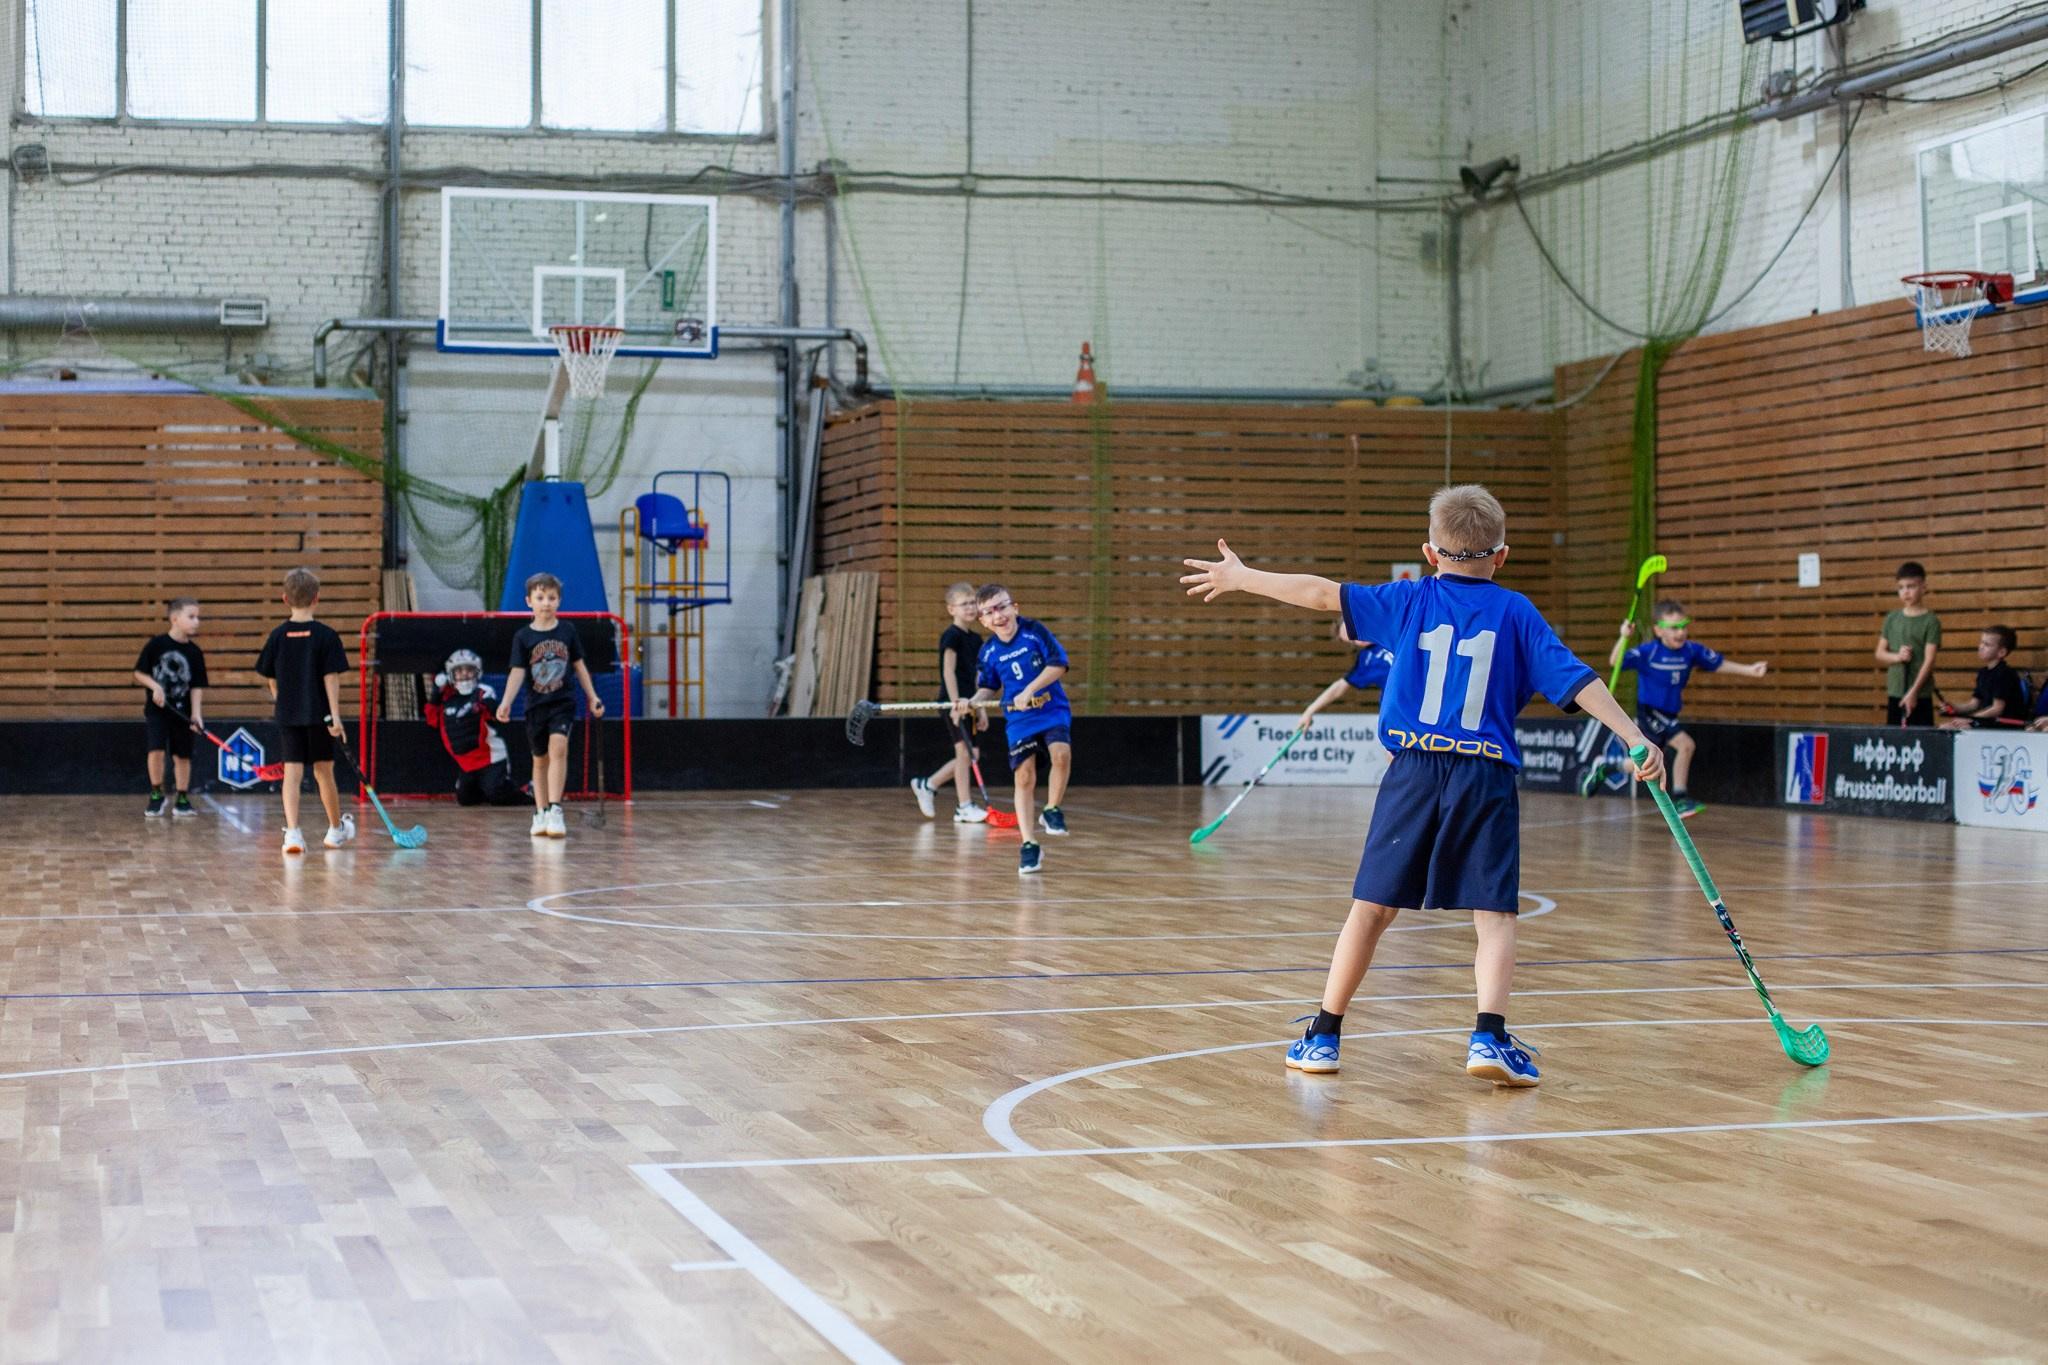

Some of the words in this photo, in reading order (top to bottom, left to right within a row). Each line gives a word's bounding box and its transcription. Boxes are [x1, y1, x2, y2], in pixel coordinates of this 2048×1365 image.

[1011, 661, 1024, 681] 9
[1417, 623, 1496, 732] 11
[1340, 726, 1375, 742] club
[1555, 729, 1576, 748] club
[1322, 747, 1355, 765] City
[1546, 750, 1566, 773] City
[1853, 738, 1925, 772] нффр.рф
[1835, 773, 1947, 805] #russiafloorball
